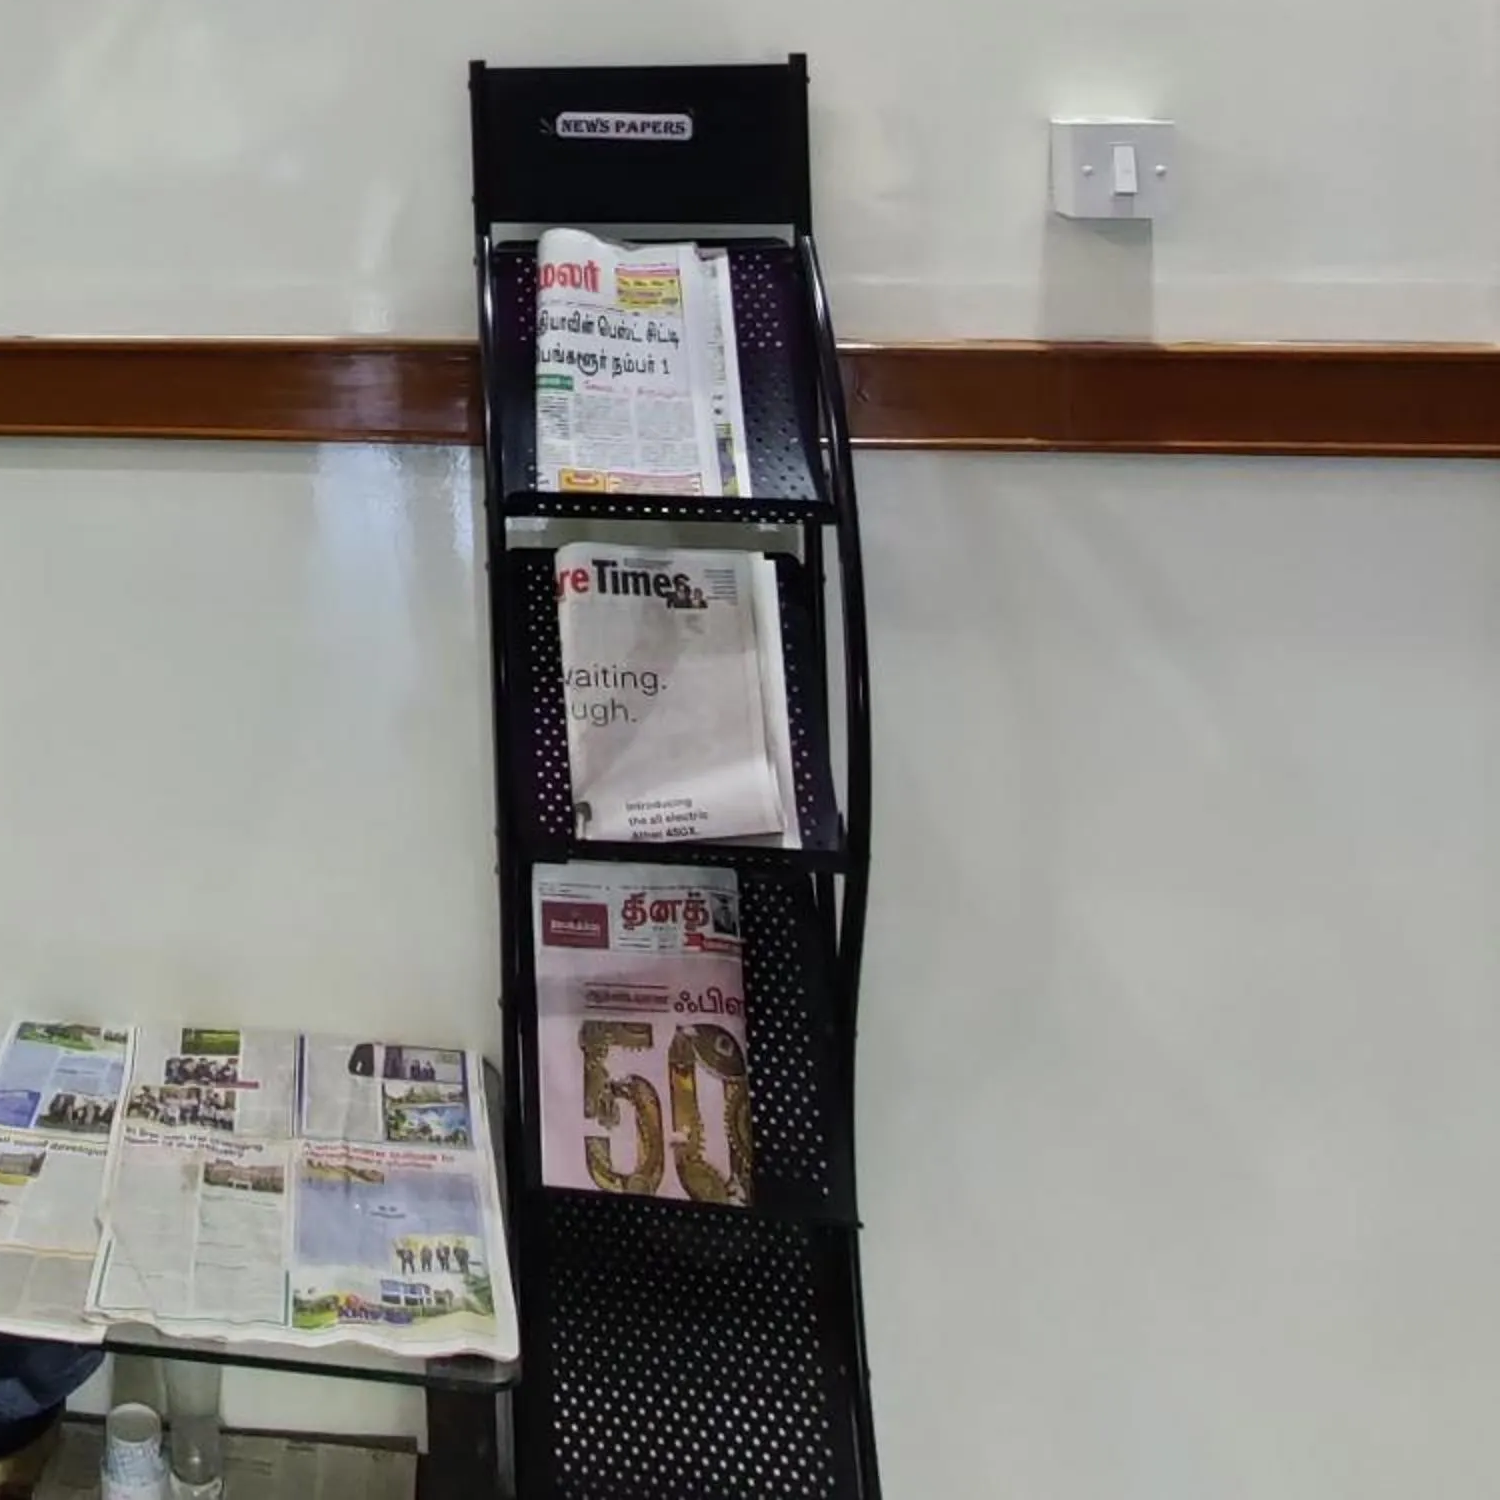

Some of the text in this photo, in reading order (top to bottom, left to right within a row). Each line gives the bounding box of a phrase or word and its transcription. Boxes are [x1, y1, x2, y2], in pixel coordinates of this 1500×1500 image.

[615, 121, 685, 135] PAPERS
[662, 358, 670, 375] 1
[578, 1019, 753, 1206] 50
